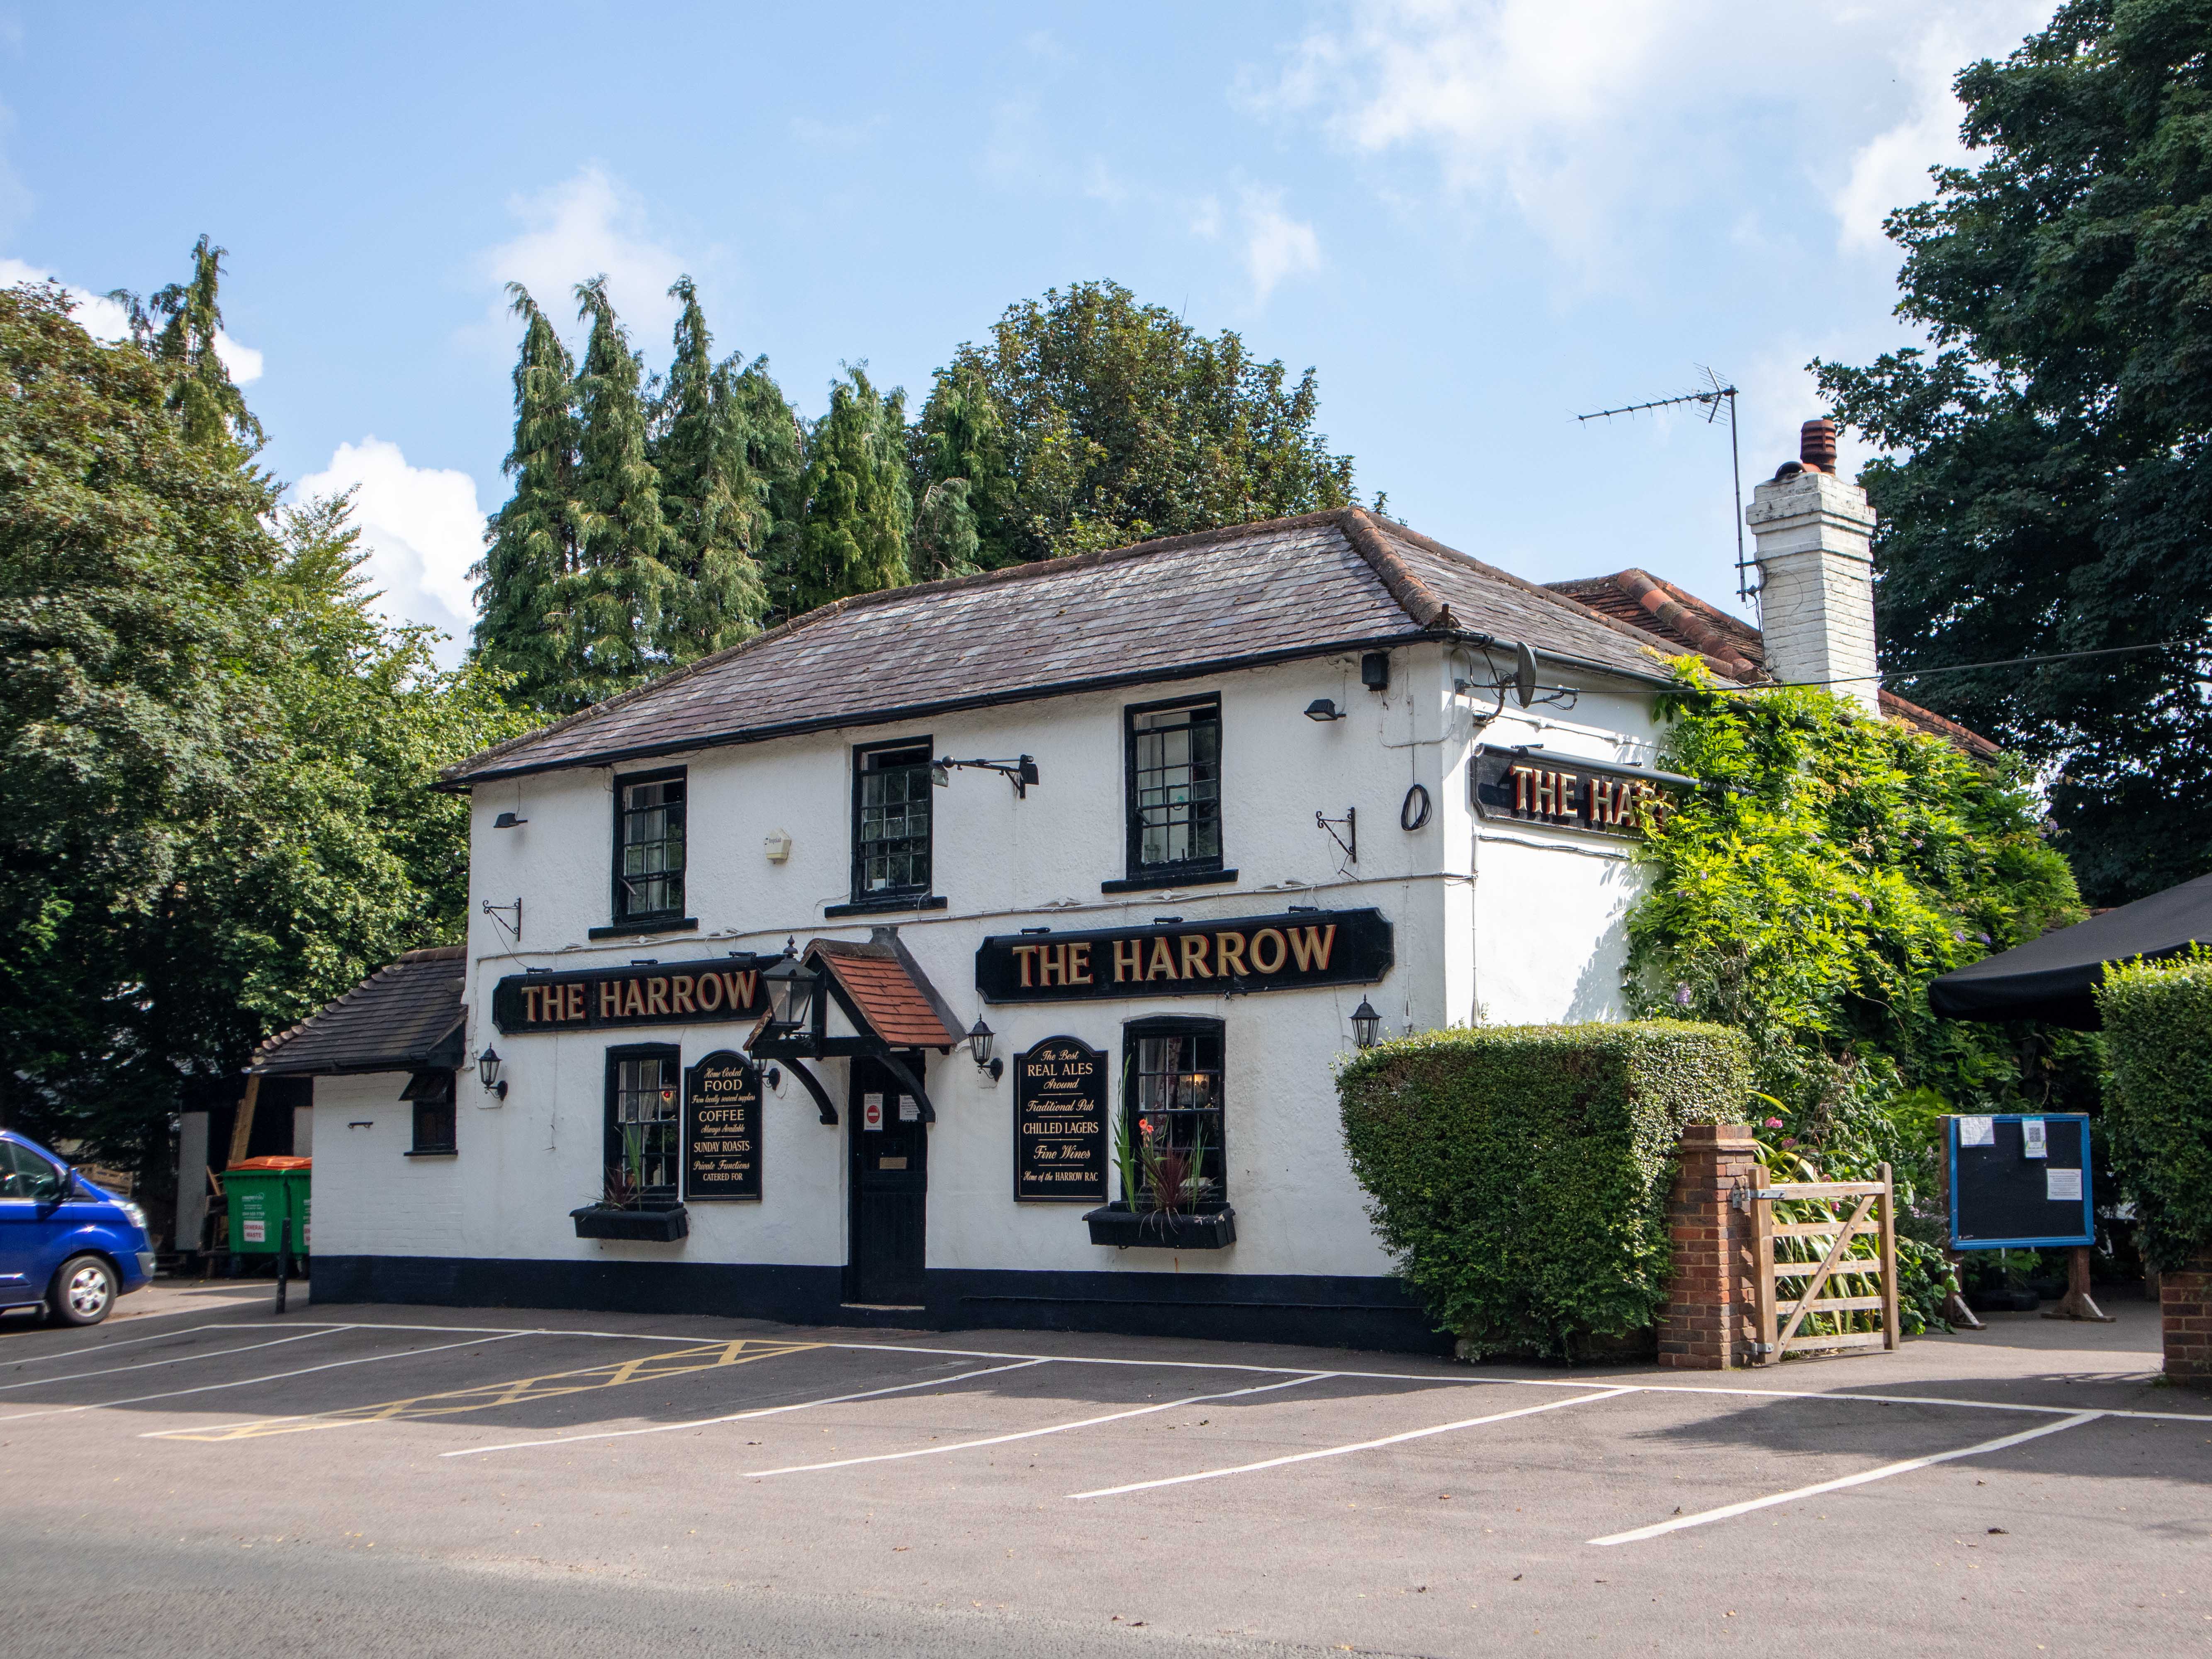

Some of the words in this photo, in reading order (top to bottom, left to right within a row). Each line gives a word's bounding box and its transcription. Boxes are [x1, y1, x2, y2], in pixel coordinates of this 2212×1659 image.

[1509, 765, 1577, 817] THE
[1012, 941, 1093, 988] THE
[1112, 924, 1337, 983] HARROW
[521, 983, 586, 1022] THE
[599, 970, 758, 1018] HARROW
[1041, 1050, 1055, 1061] The
[1059, 1049, 1079, 1060] Best
[704, 1068, 720, 1078] Home
[722, 1067, 743, 1077] Cooked
[1027, 1064, 1057, 1076] REAL
[1062, 1063, 1093, 1075] ALES
[704, 1079, 742, 1092] FOOD
[1044, 1078, 1080, 1089] Around
[691, 1095, 704, 1104] From
[705, 1095, 720, 1104] locally
[1026, 1100, 1076, 1112] Traditional
[1076, 1099, 1094, 1112] Pub
[698, 1109, 745, 1122] COFFEE
[701, 1125, 720, 1135] Always
[721, 1124, 745, 1133] Available
[1023, 1123, 1062, 1134] CHILLED
[1065, 1122, 1099, 1134] LAGERS
[694, 1141, 720, 1152] SUNDAY
[723, 1141, 750, 1151] ROASTS
[1034, 1145, 1057, 1159] Fine
[1059, 1145, 1090, 1159] Wines
[694, 1160, 715, 1170] Private
[718, 1160, 750, 1170] Functions
[1023, 1171, 1037, 1181] Home
[1038, 1172, 1044, 1182] of
[1055, 1172, 1083, 1181] HARROW
[1085, 1172, 1099, 1181] RAC
